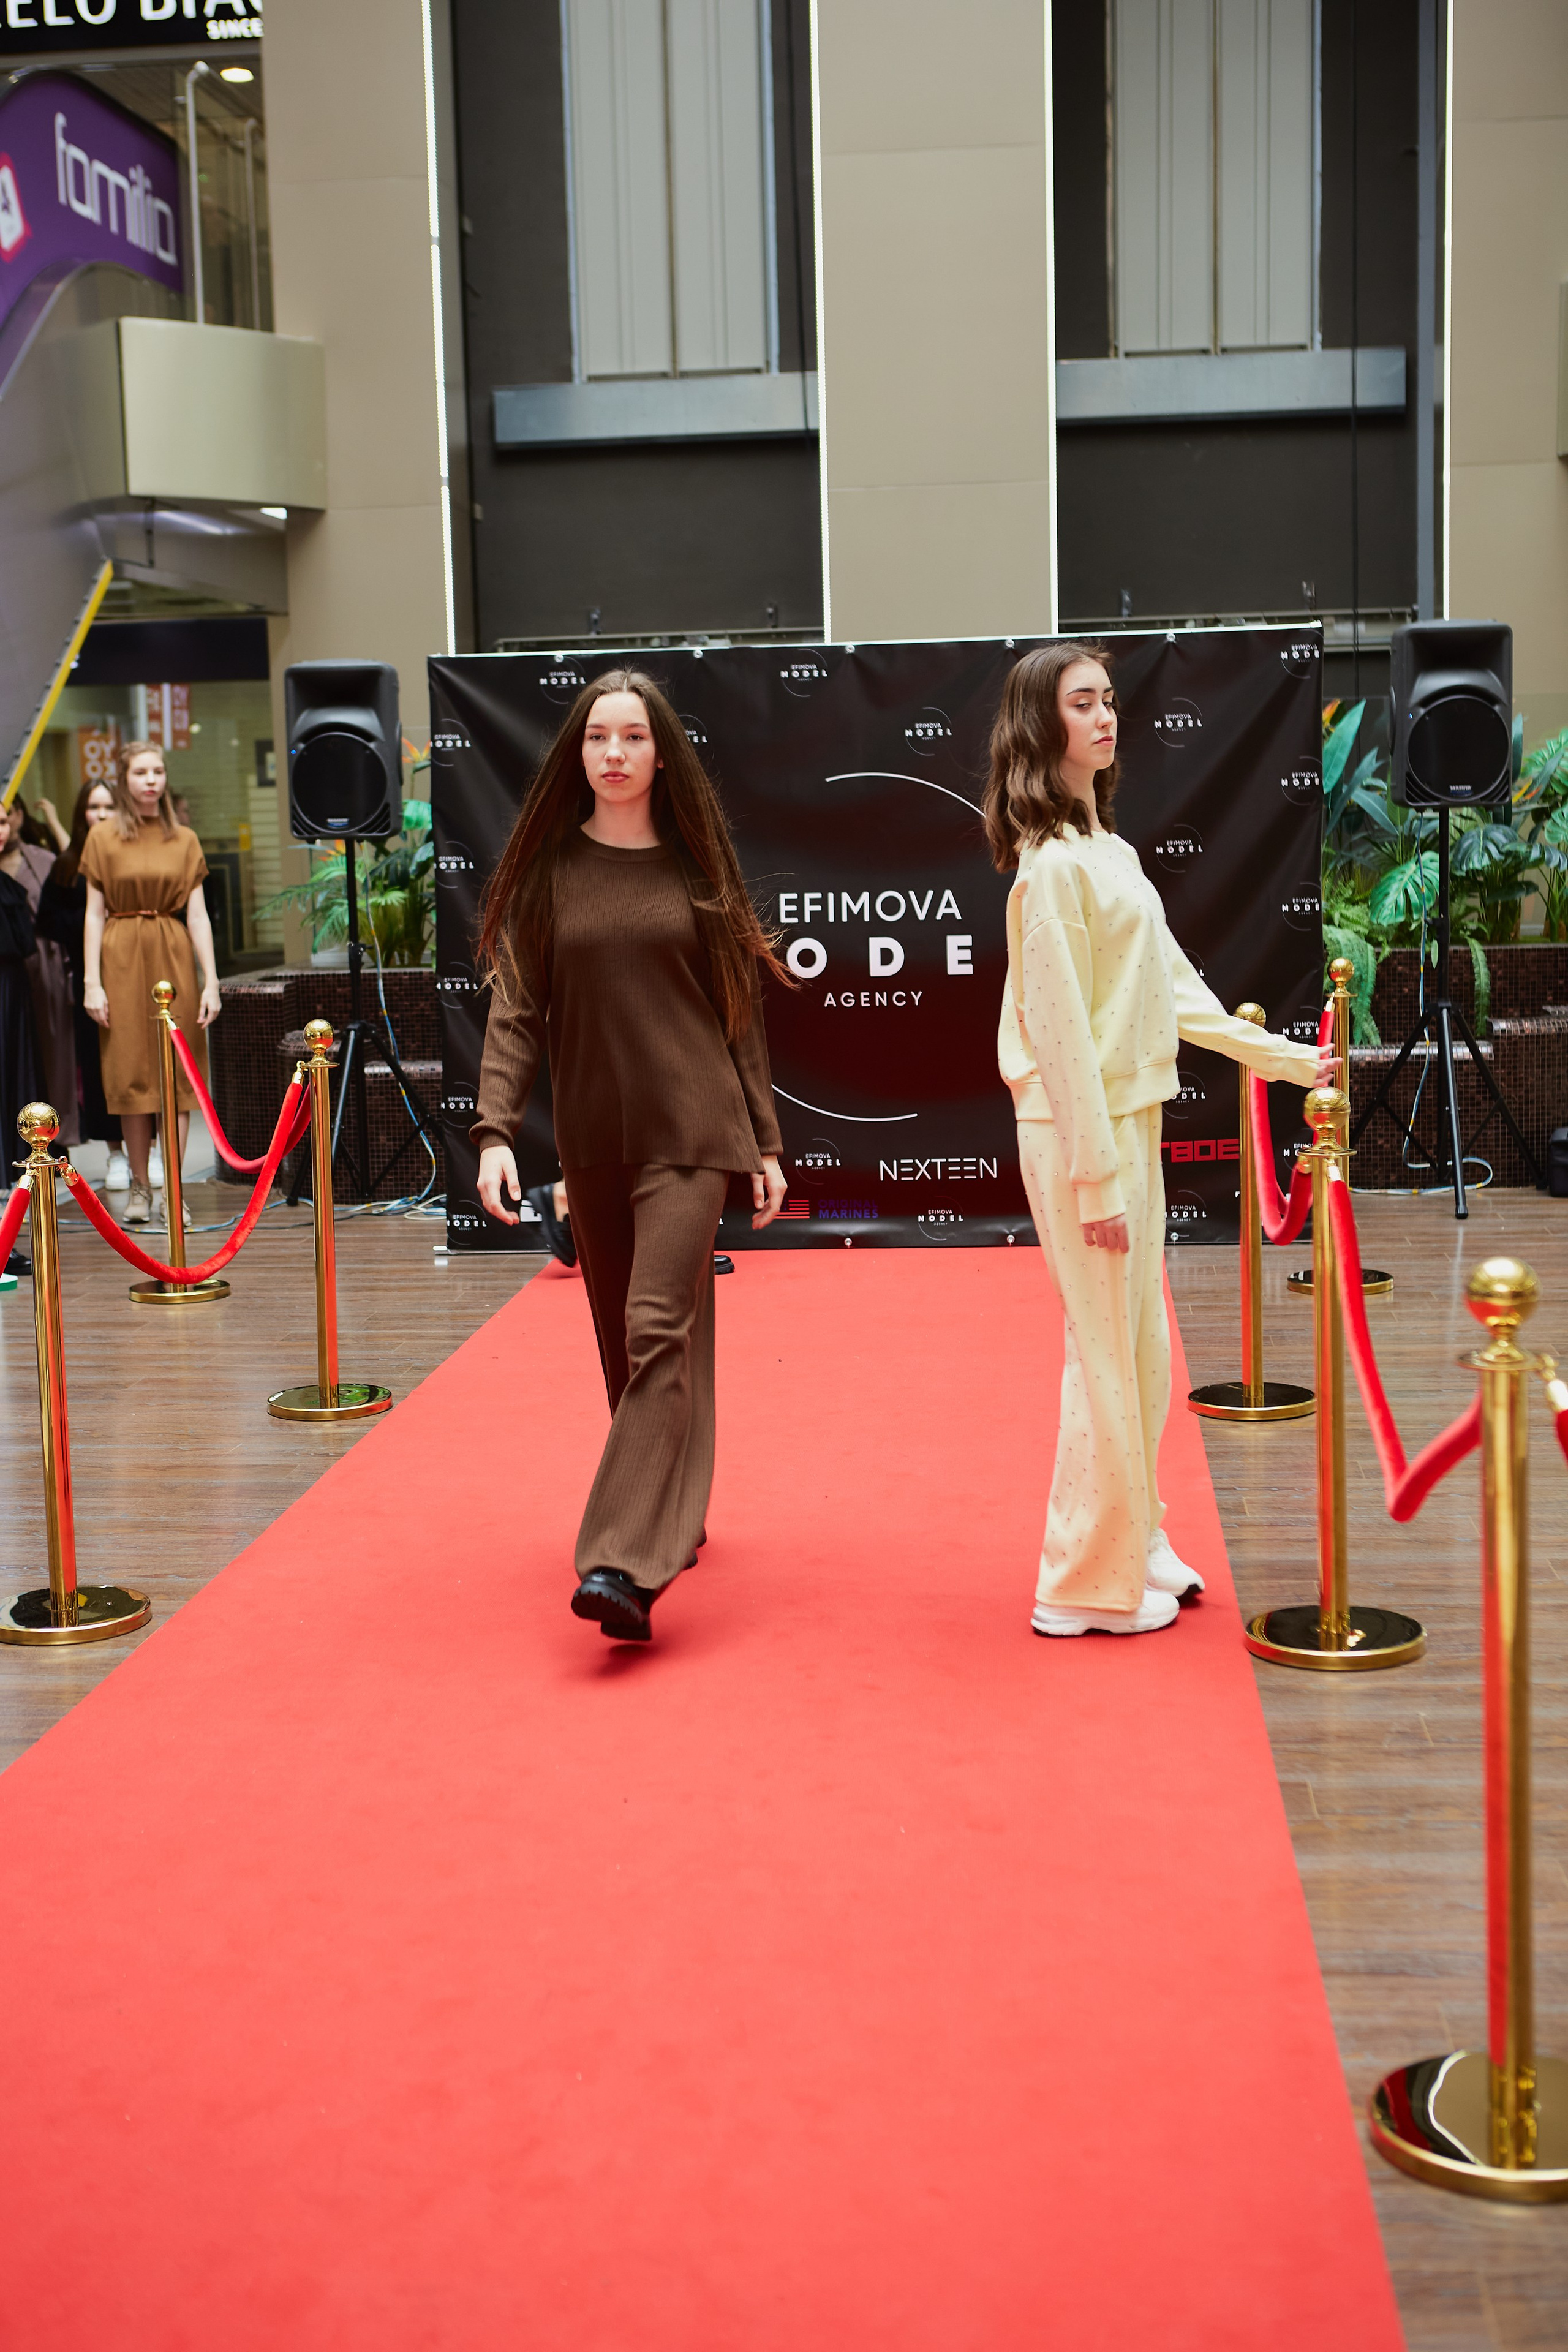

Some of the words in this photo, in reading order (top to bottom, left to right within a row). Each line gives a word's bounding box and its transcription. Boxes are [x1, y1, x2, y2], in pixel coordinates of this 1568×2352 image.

[206, 17, 264, 40] SINCE
[1280, 650, 1320, 660] MODE
[780, 669, 828, 678] MODEL
[1154, 718, 1203, 728] MODEL
[905, 728, 952, 737] MODEL
[431, 739, 472, 748] ODEL
[1281, 778, 1319, 787] MODE
[1156, 844, 1203, 854] MODEL
[434, 861, 475, 870] ODEL
[779, 889, 962, 923] EFIMOVA
[1281, 903, 1320, 912] MODE
[786, 934, 974, 979] ODE
[824, 991, 922, 1008] AGENCY
[1282, 1027, 1320, 1036] MODE
[880, 1158, 998, 1181] NEXTEEN
[818, 1199, 878, 1208] ORIGINAL
[818, 1208, 879, 1219] MARINES
[918, 1214, 963, 1223] MODEL
